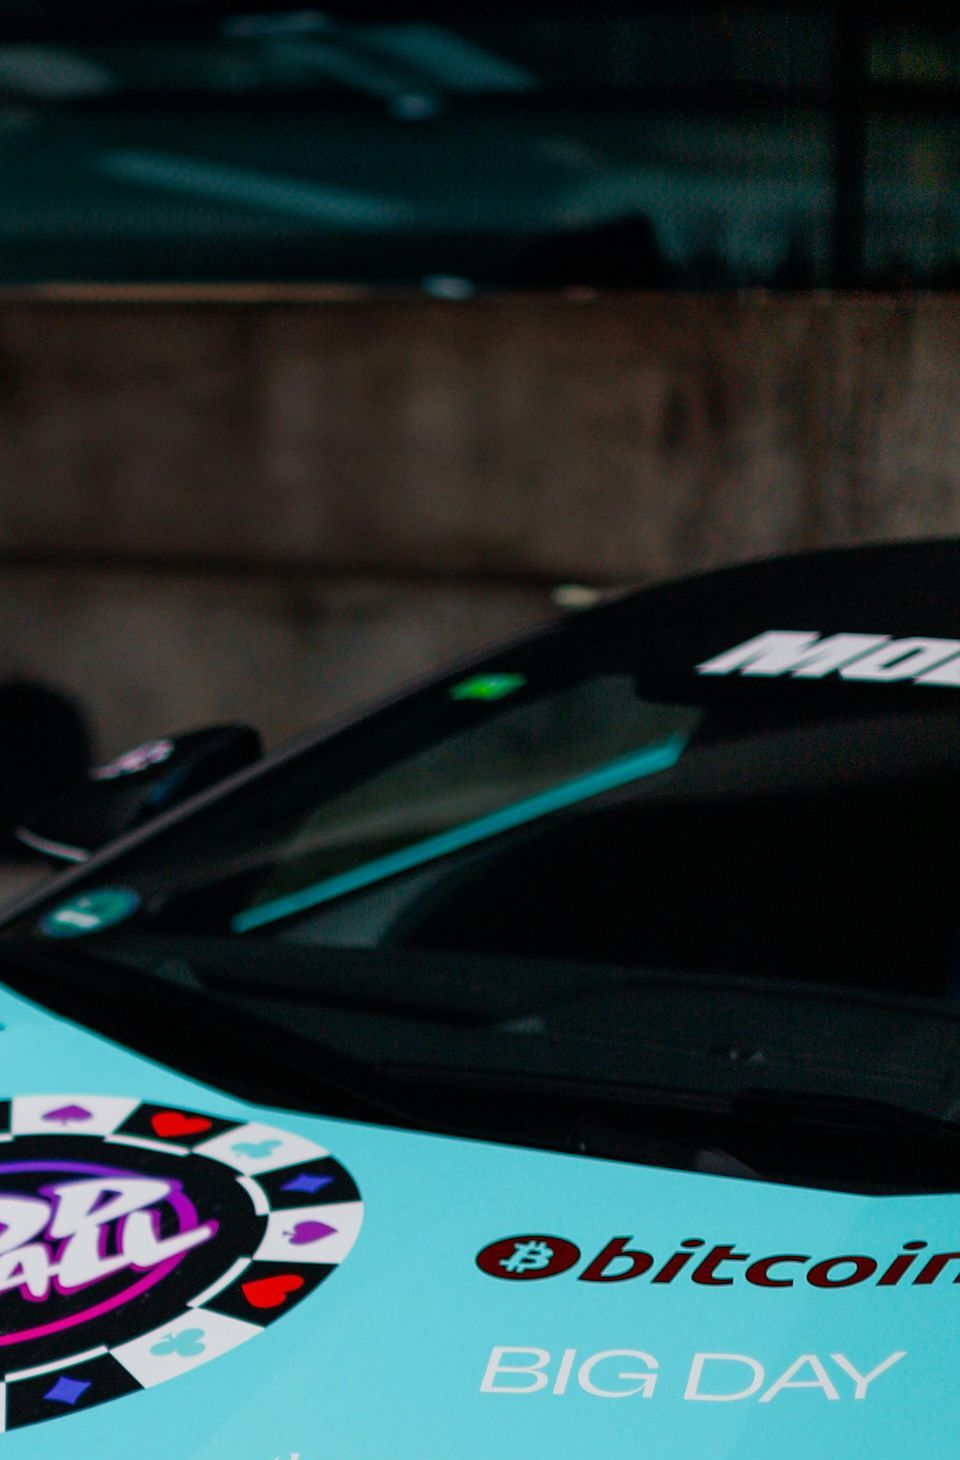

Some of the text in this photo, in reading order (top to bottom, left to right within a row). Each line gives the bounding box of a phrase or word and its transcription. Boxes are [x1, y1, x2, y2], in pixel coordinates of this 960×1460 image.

[577, 1236, 960, 1288] bitcoin
[479, 1346, 907, 1403] BIG DAY
